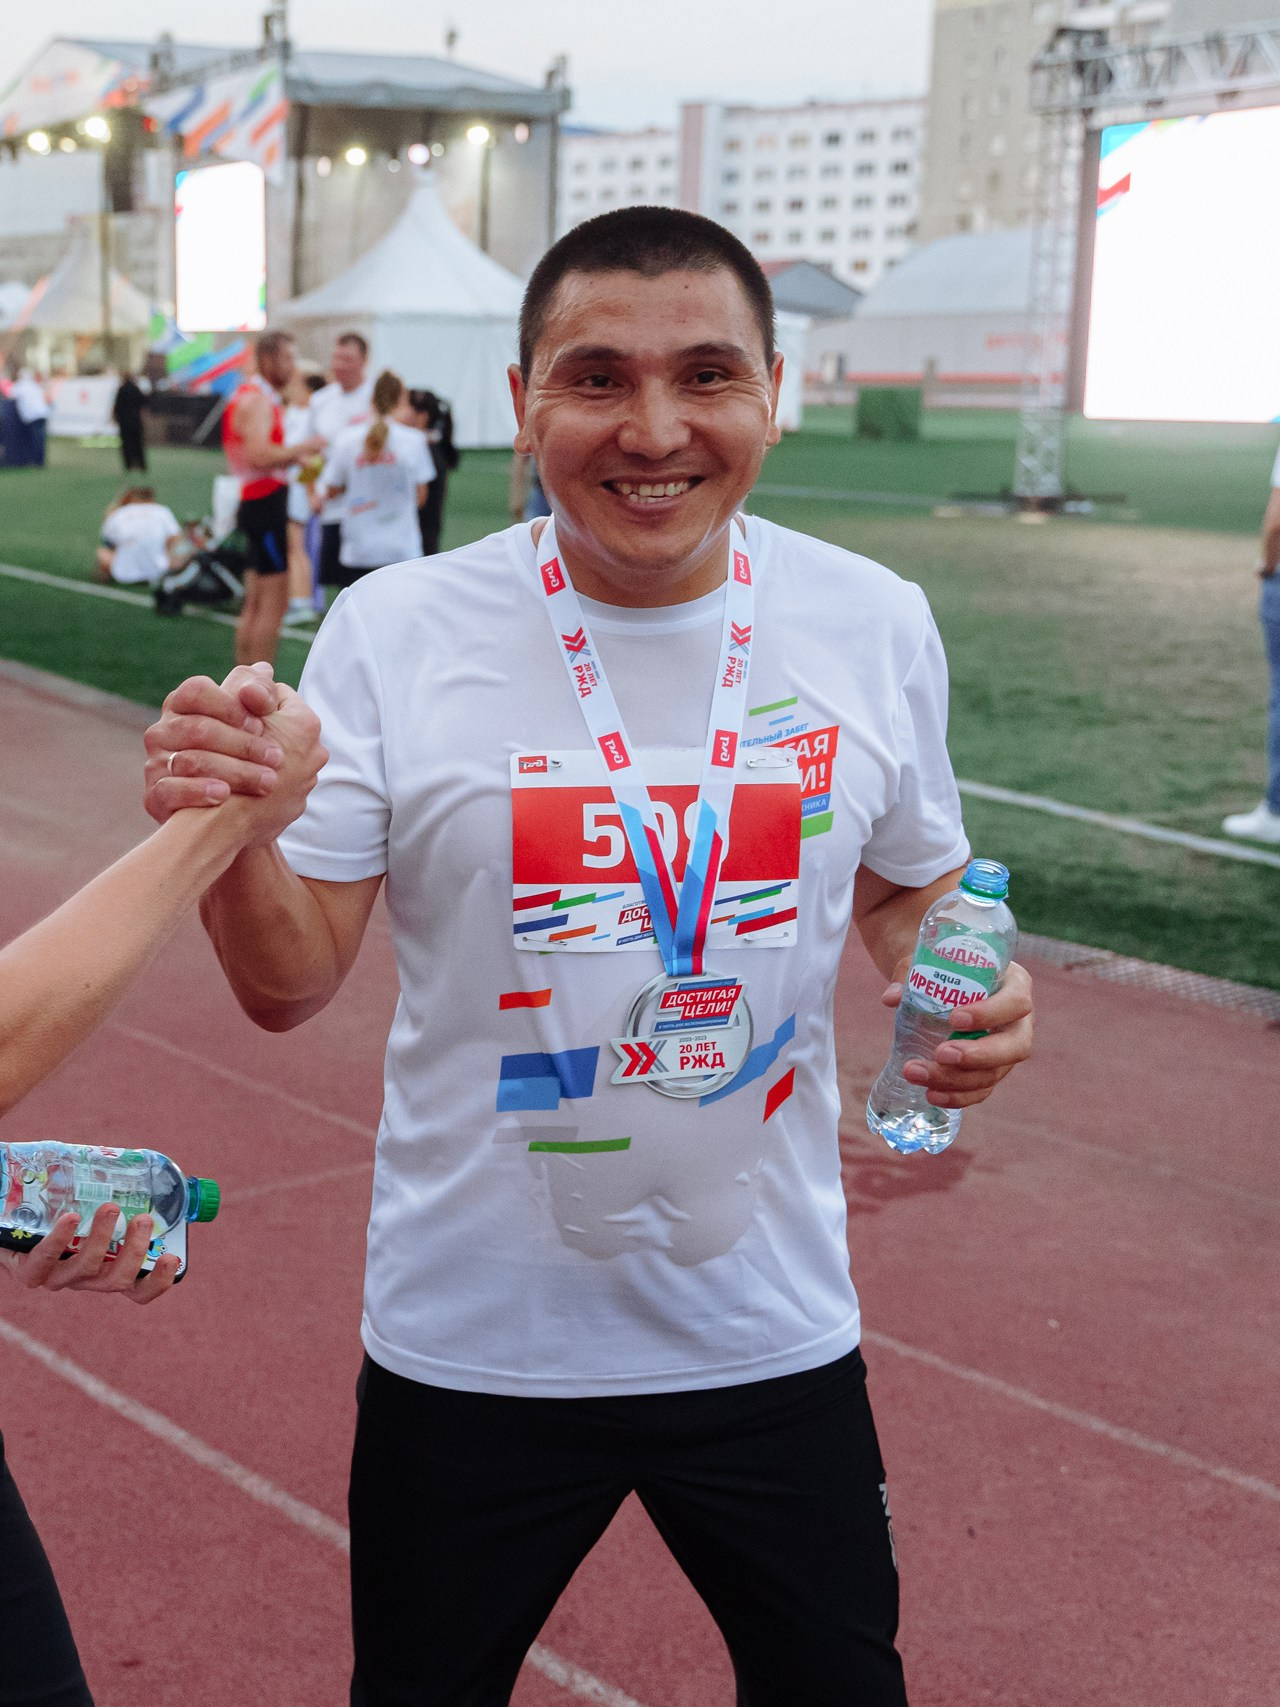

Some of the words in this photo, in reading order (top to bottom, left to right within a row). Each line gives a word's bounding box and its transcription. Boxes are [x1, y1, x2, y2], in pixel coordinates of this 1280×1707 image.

[583, 662, 592, 672] 20
[737, 658, 744, 668] 20
[721, 656, 736, 688] РЖД
[735, 669, 743, 684] ЛЕТ
[573, 665, 592, 698] РЖД
[587, 673, 598, 687] ЛЕТ
[785, 723, 810, 737] ЗАБЕГ
[933, 971, 962, 986] aqua
[910, 969, 987, 1007] ИРЕНДЫК
[666, 988, 737, 1007] ДОСТИГАЯ
[685, 1001, 731, 1018] ЦЕЛИ!
[679, 1045, 692, 1054] 20
[695, 1041, 717, 1053] ЛЕТ
[679, 1052, 725, 1070] РЖД
